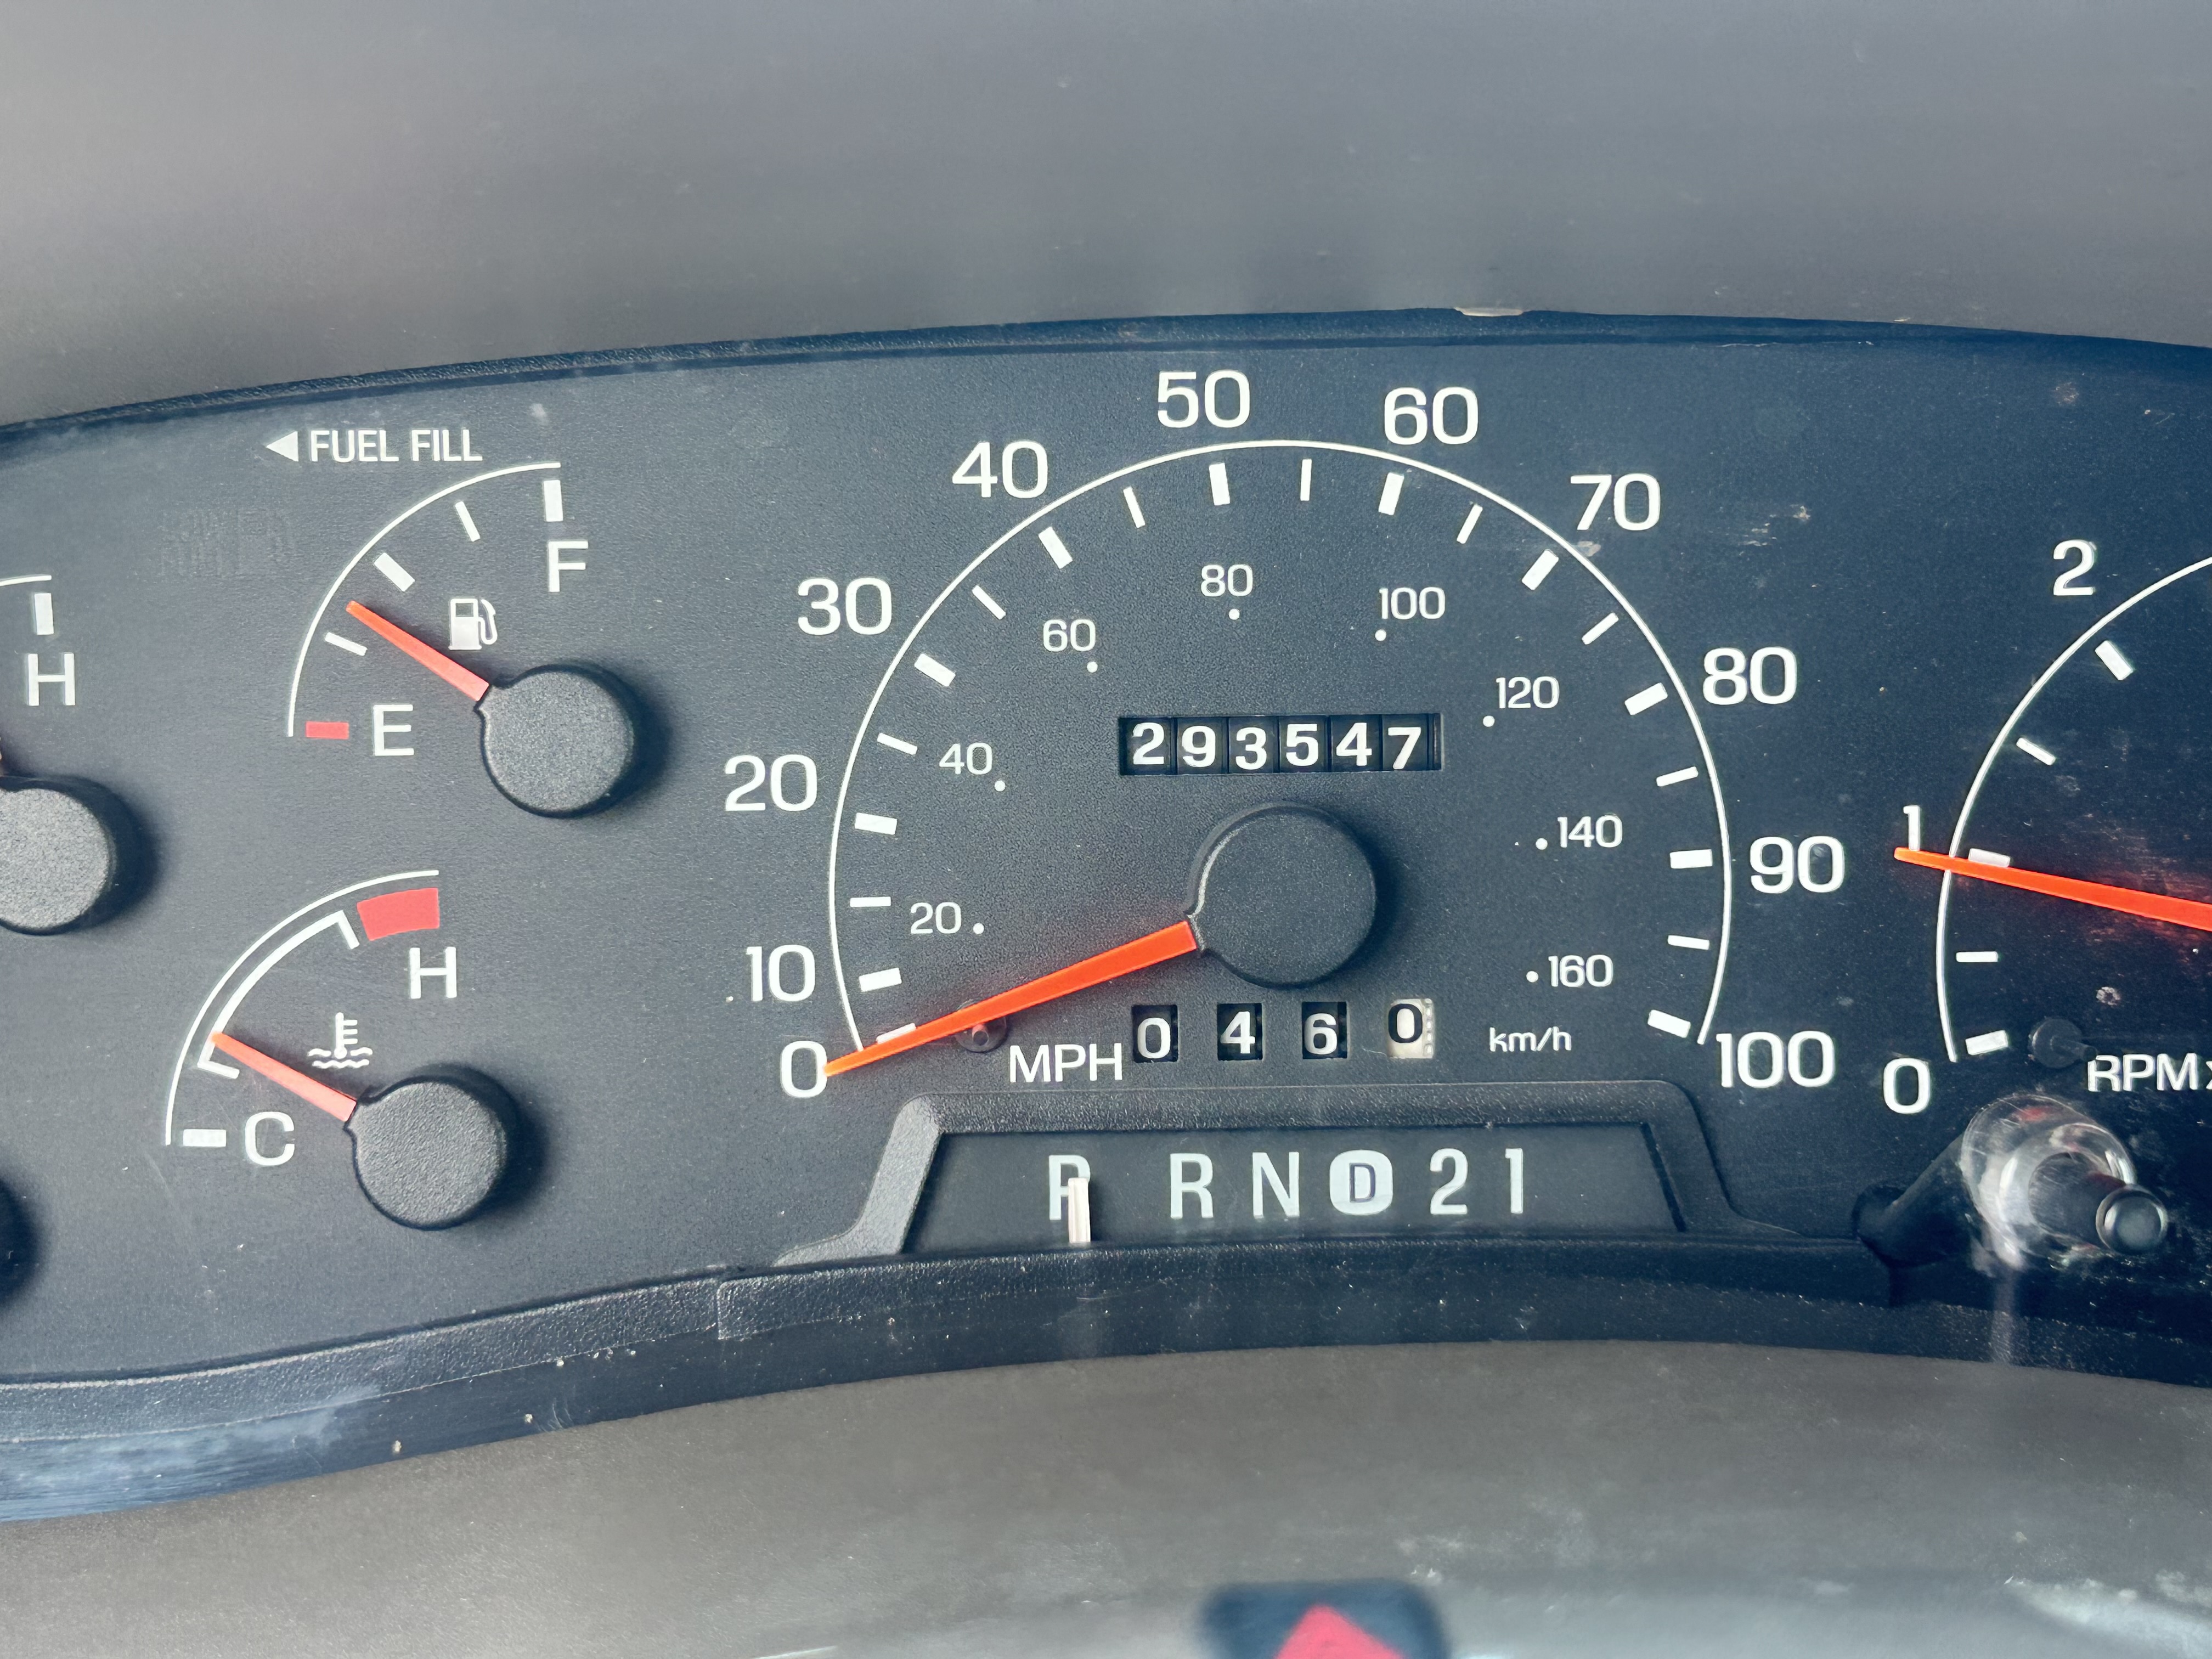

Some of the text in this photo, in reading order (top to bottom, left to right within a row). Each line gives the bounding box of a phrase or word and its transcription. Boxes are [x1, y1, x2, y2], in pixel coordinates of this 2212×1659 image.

[1158, 370, 1250, 427] 50
[1385, 387, 1478, 444] 60
[311, 430, 482, 462] FUEL FILL
[952, 441, 1048, 498] 40
[1571, 473, 1660, 530] 70
[548, 541, 588, 592] F
[1201, 565, 1252, 596] 80
[2053, 539, 2094, 596] 2
[798, 578, 891, 635] 30
[1379, 587, 1445, 619] 100
[1043, 619, 1096, 651] 60
[28, 653, 75, 706] H
[1496, 676, 1559, 708] 120
[1703, 647, 1797, 704] 80
[373, 704, 414, 756] E
[1133, 723, 1421, 770] 293547
[725, 754, 817, 811] 20
[939, 743, 992, 775] 40
[1558, 815, 1622, 848] 140
[1903, 805, 1920, 851] 1
[1750, 836, 1844, 893] 90
[911, 902, 961, 934] 20
[409, 947, 456, 998] H
[746, 945, 815, 1001] 10
[1549, 955, 1613, 987] 160
[1010, 1043, 1122, 1082] MPH
[1490, 1026, 1571, 1052] km/h
[1716, 1031, 1835, 1088] 100
[780, 1040, 828, 1098] 0
[1883, 1058, 1930, 1114] 0
[2087, 1053, 2212, 1092] RPM
[245, 1111, 295, 1166] C
[1048, 1154, 1091, 1220] P
[1171, 1153, 1213, 1218] R
[1252, 1152, 1299, 1218] N
[1430, 1149, 1468, 1215] 2
[1505, 1148, 1523, 1214] 1
